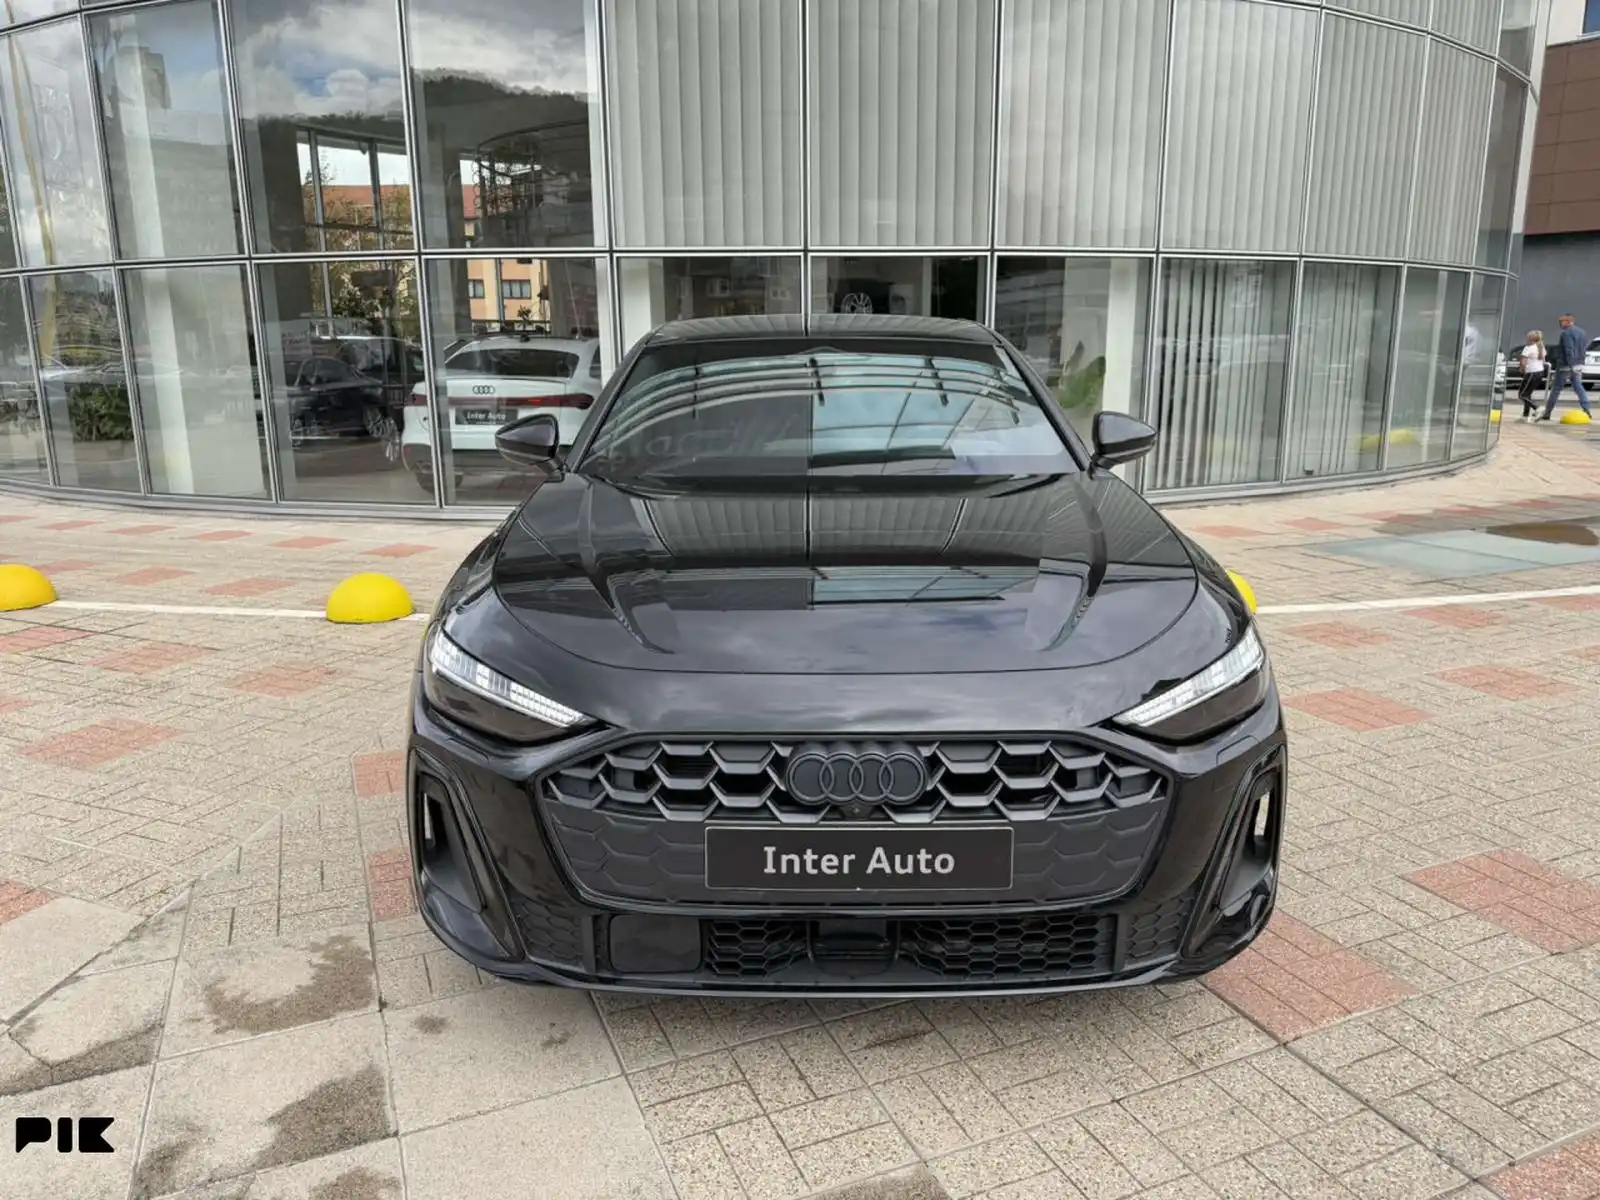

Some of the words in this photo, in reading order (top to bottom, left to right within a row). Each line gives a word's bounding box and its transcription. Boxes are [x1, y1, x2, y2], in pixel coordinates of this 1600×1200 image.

[467, 411, 486, 420] Inter
[487, 411, 506, 420] Auto
[763, 846, 855, 874] Inter
[866, 846, 955, 874] Auto
